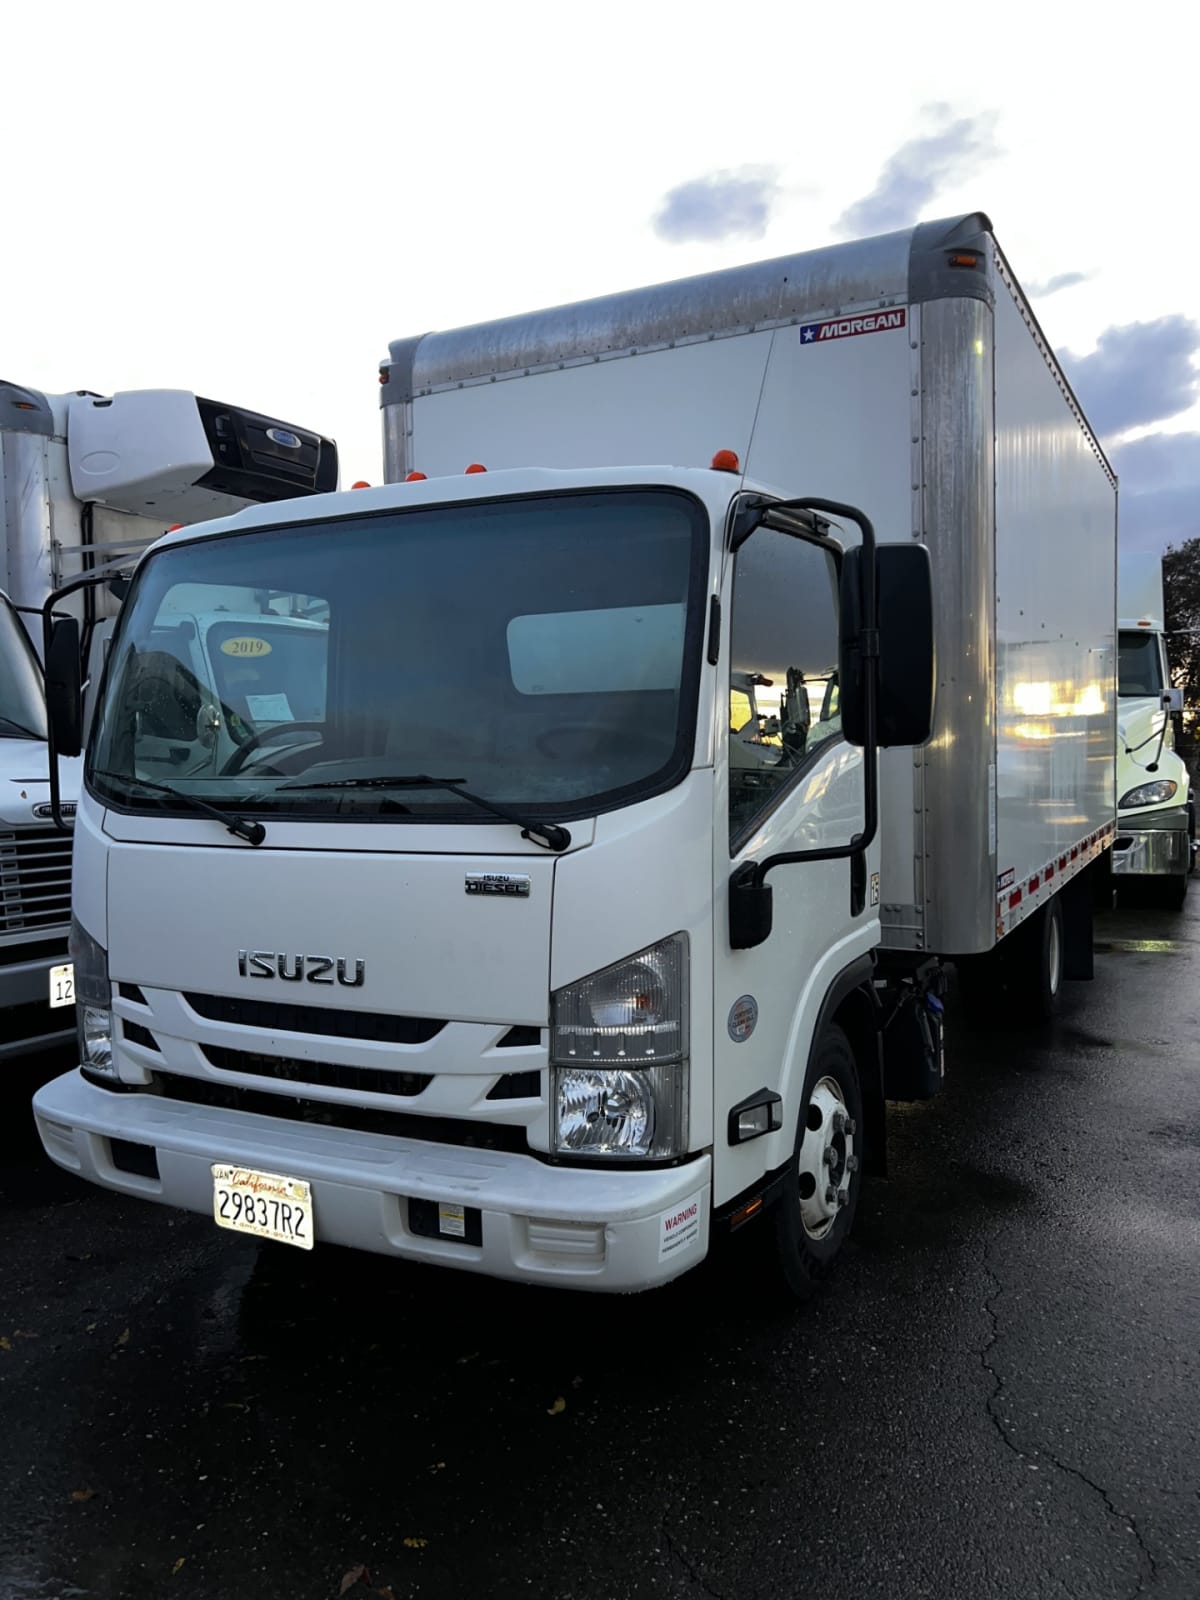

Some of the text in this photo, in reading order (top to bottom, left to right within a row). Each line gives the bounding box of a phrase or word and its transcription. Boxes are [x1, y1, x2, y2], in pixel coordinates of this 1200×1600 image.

[820, 313, 901, 338] MORGAN
[232, 641, 263, 654] 2019
[467, 882, 529, 895] DIESEL
[483, 874, 510, 882] ISUZU
[238, 949, 365, 988] ISUZU
[56, 980, 73, 1000] 12
[232, 1171, 287, 1196] California
[218, 1190, 305, 1238] 29837R2
[664, 1203, 697, 1231] WARNING
